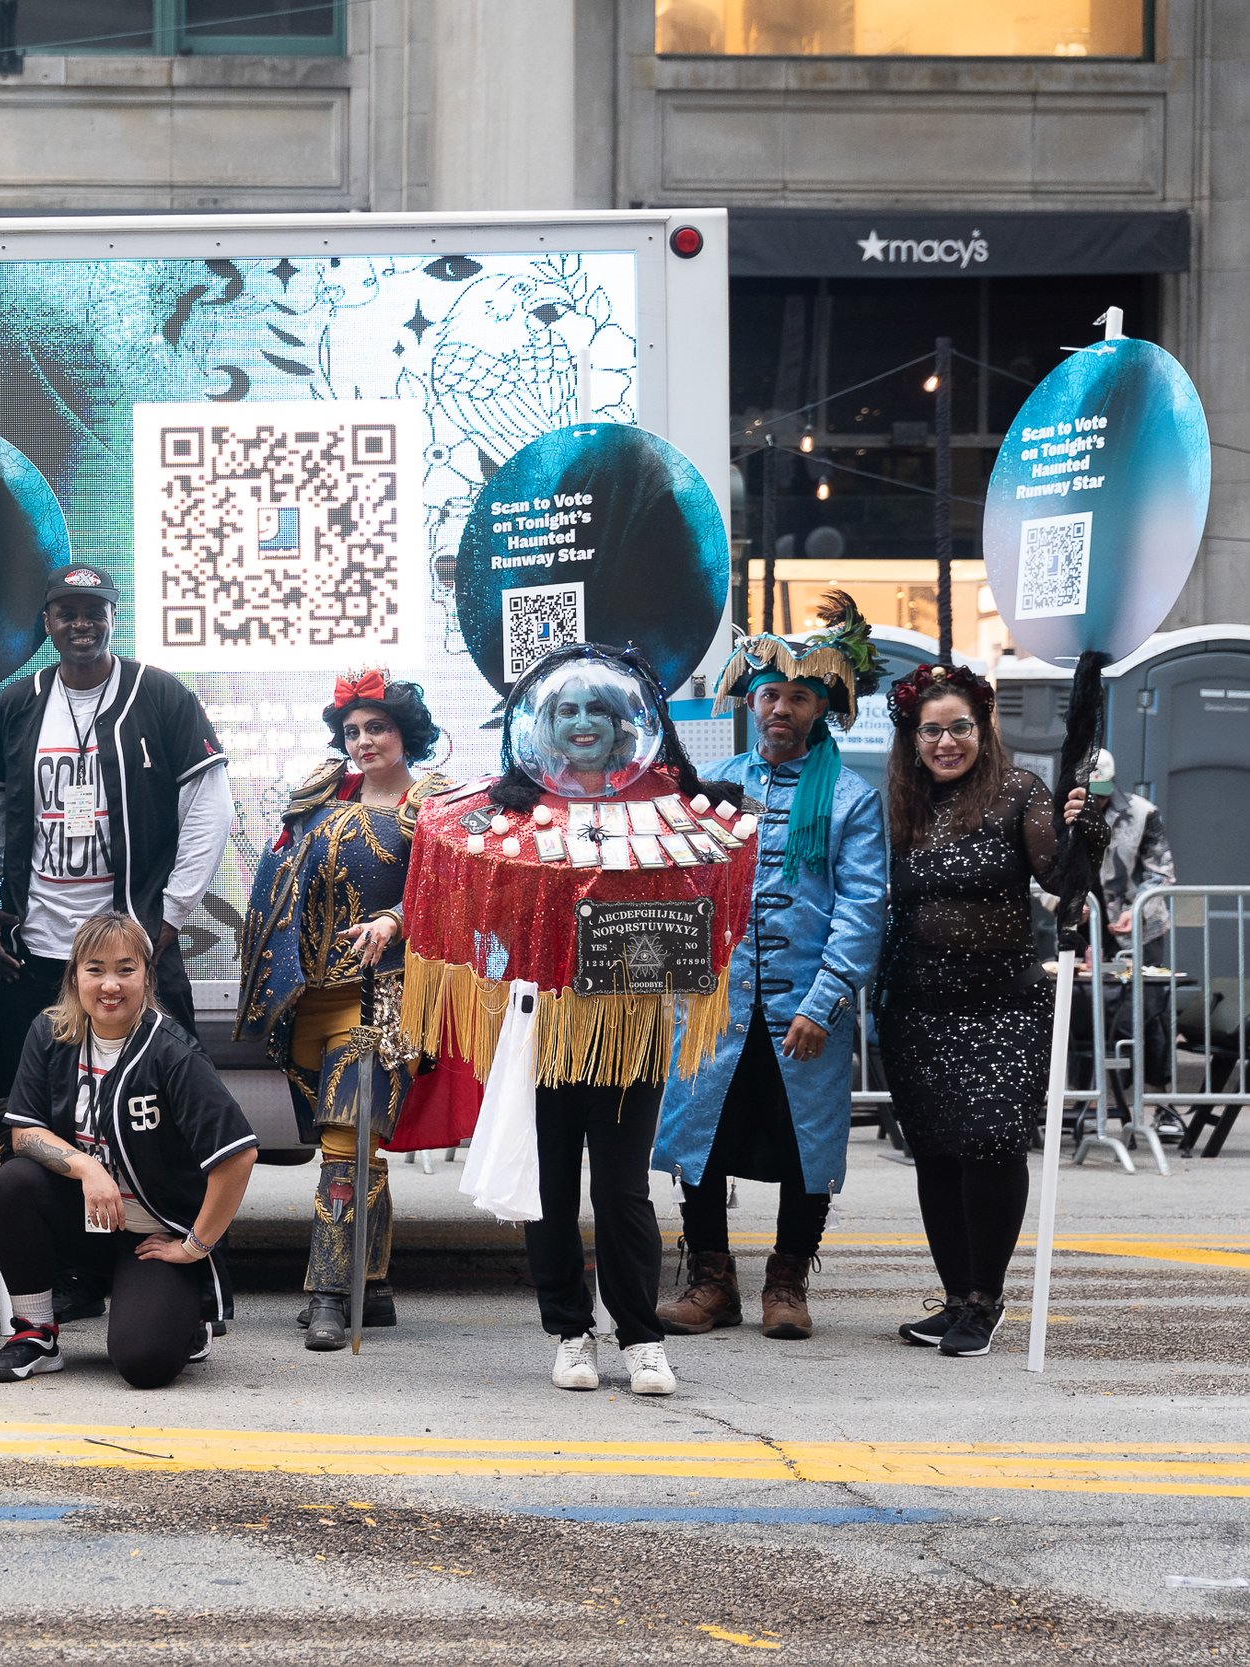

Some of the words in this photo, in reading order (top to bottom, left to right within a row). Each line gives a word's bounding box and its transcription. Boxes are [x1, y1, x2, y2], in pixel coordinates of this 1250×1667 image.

[889, 228, 989, 269] macy's
[1021, 426, 1055, 442] Scan
[1057, 422, 1072, 436] to
[1074, 415, 1108, 433] Vote
[1021, 448, 1038, 461] on
[1041, 434, 1105, 457] Tonight's
[1032, 454, 1090, 479] Haunted
[1015, 480, 1071, 500] Runway
[1072, 475, 1105, 491] Star
[490, 501, 530, 516] Scan
[533, 497, 551, 511] to
[553, 492, 593, 508] Vote
[492, 521, 513, 534] on
[515, 509, 592, 531] Tonight's
[507, 528, 576, 551] Haunted
[491, 552, 556, 570] Runway
[557, 547, 596, 563] Star
[597, 909, 693, 924] ABCDEFGHIJKLM
[591, 922, 699, 938] NOPQRSTUVWXYZ
[591, 943, 608, 951] YES
[684, 942, 698, 950] NO
[128, 1094, 161, 1131] 95
